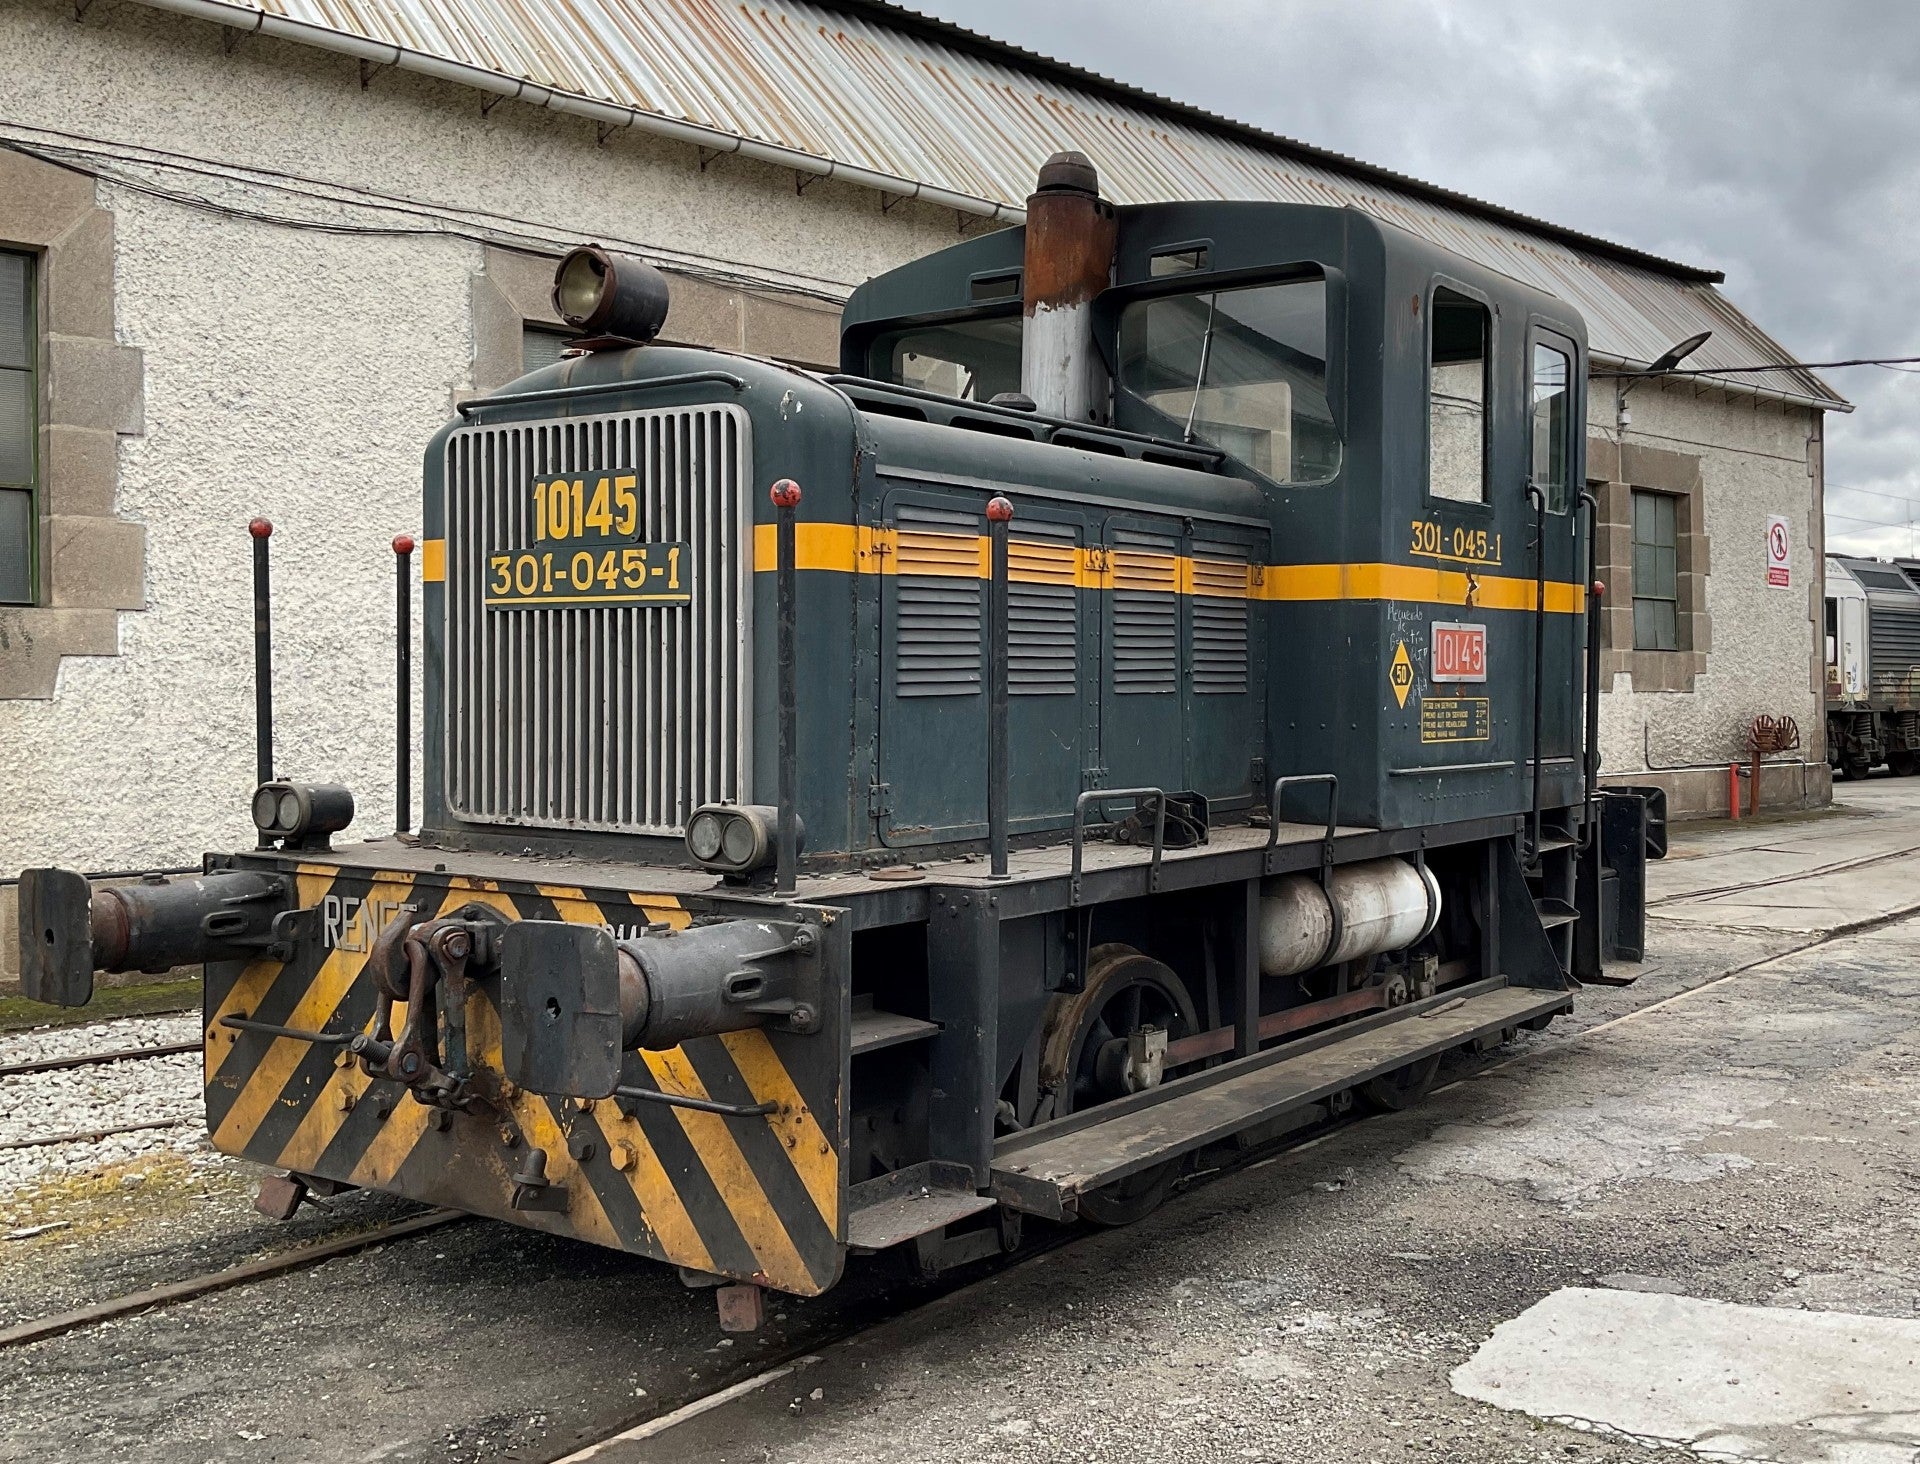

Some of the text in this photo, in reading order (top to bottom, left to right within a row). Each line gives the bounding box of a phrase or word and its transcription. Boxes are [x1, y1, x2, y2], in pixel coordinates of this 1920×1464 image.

[533, 475, 637, 541] 10145
[1411, 520, 1501, 561] 301-045-1
[490, 547, 680, 596] 301-045-1
[1396, 664, 1407, 685] 50
[1436, 633, 1483, 672] 10145
[324, 894, 418, 953] RENF
